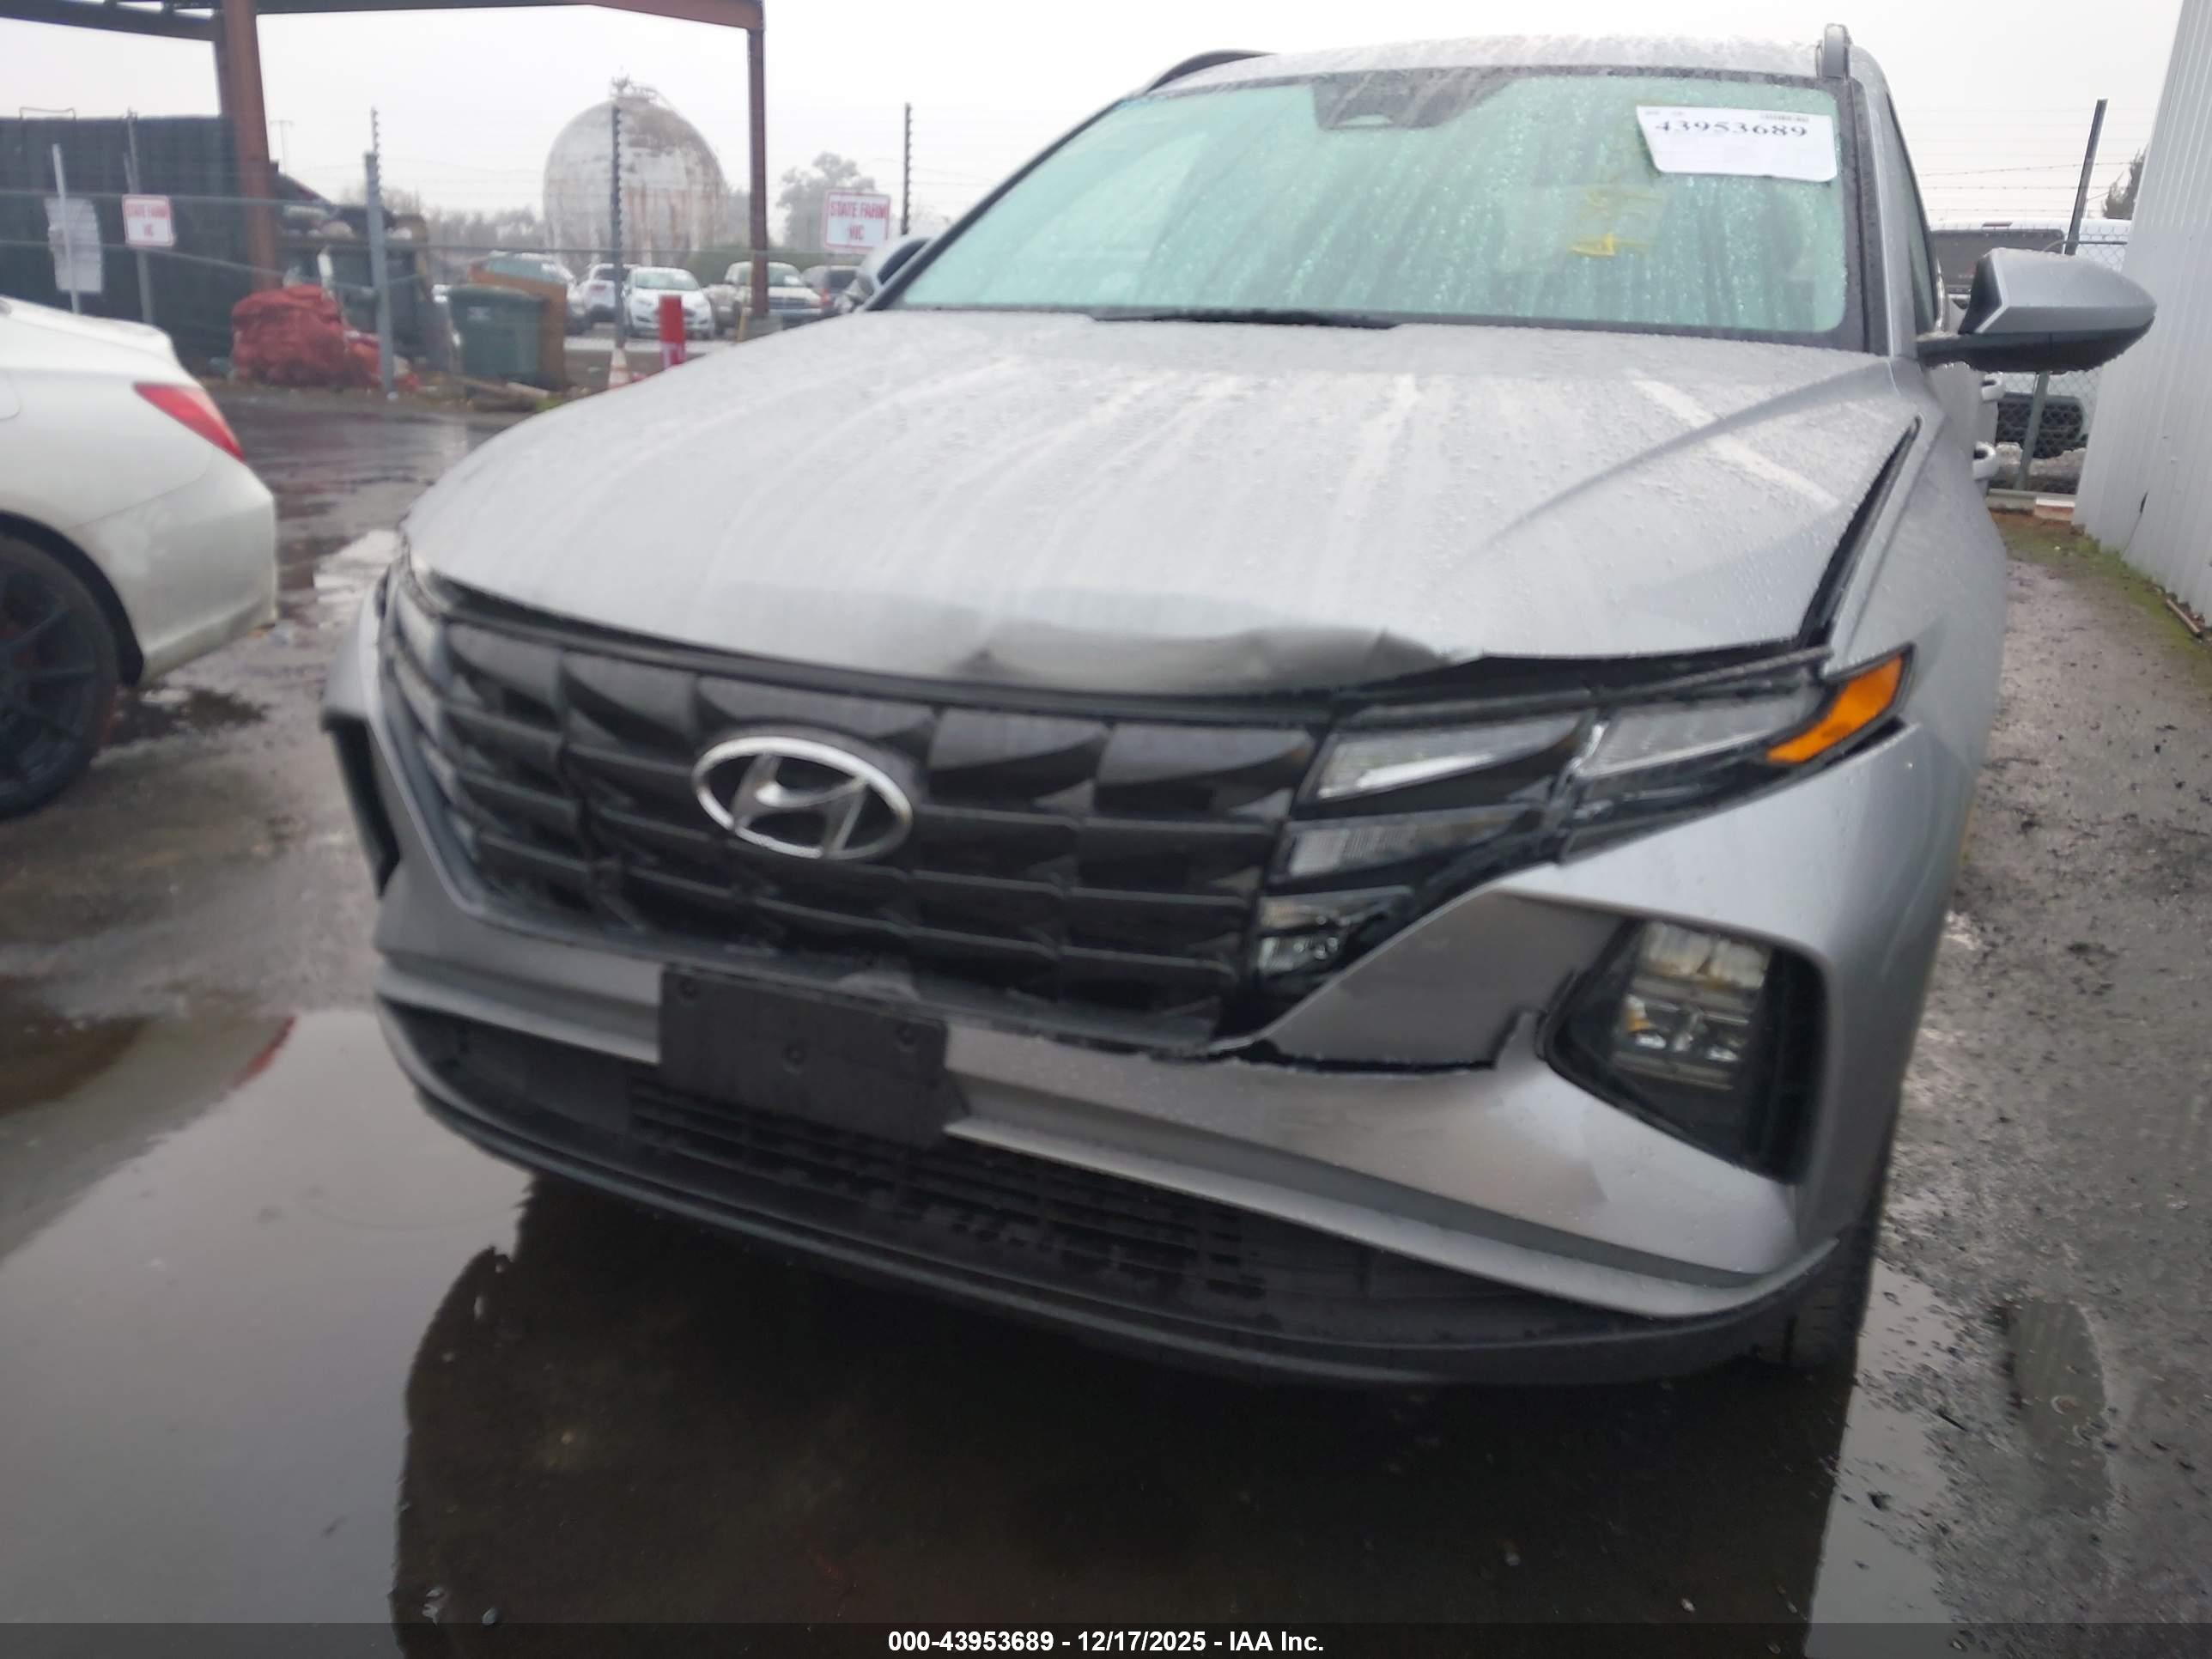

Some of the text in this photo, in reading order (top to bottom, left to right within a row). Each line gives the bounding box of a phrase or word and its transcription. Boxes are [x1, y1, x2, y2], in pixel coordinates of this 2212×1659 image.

[1656, 120, 1807, 137] 43953689
[830, 200, 888, 220] STATE FARM
